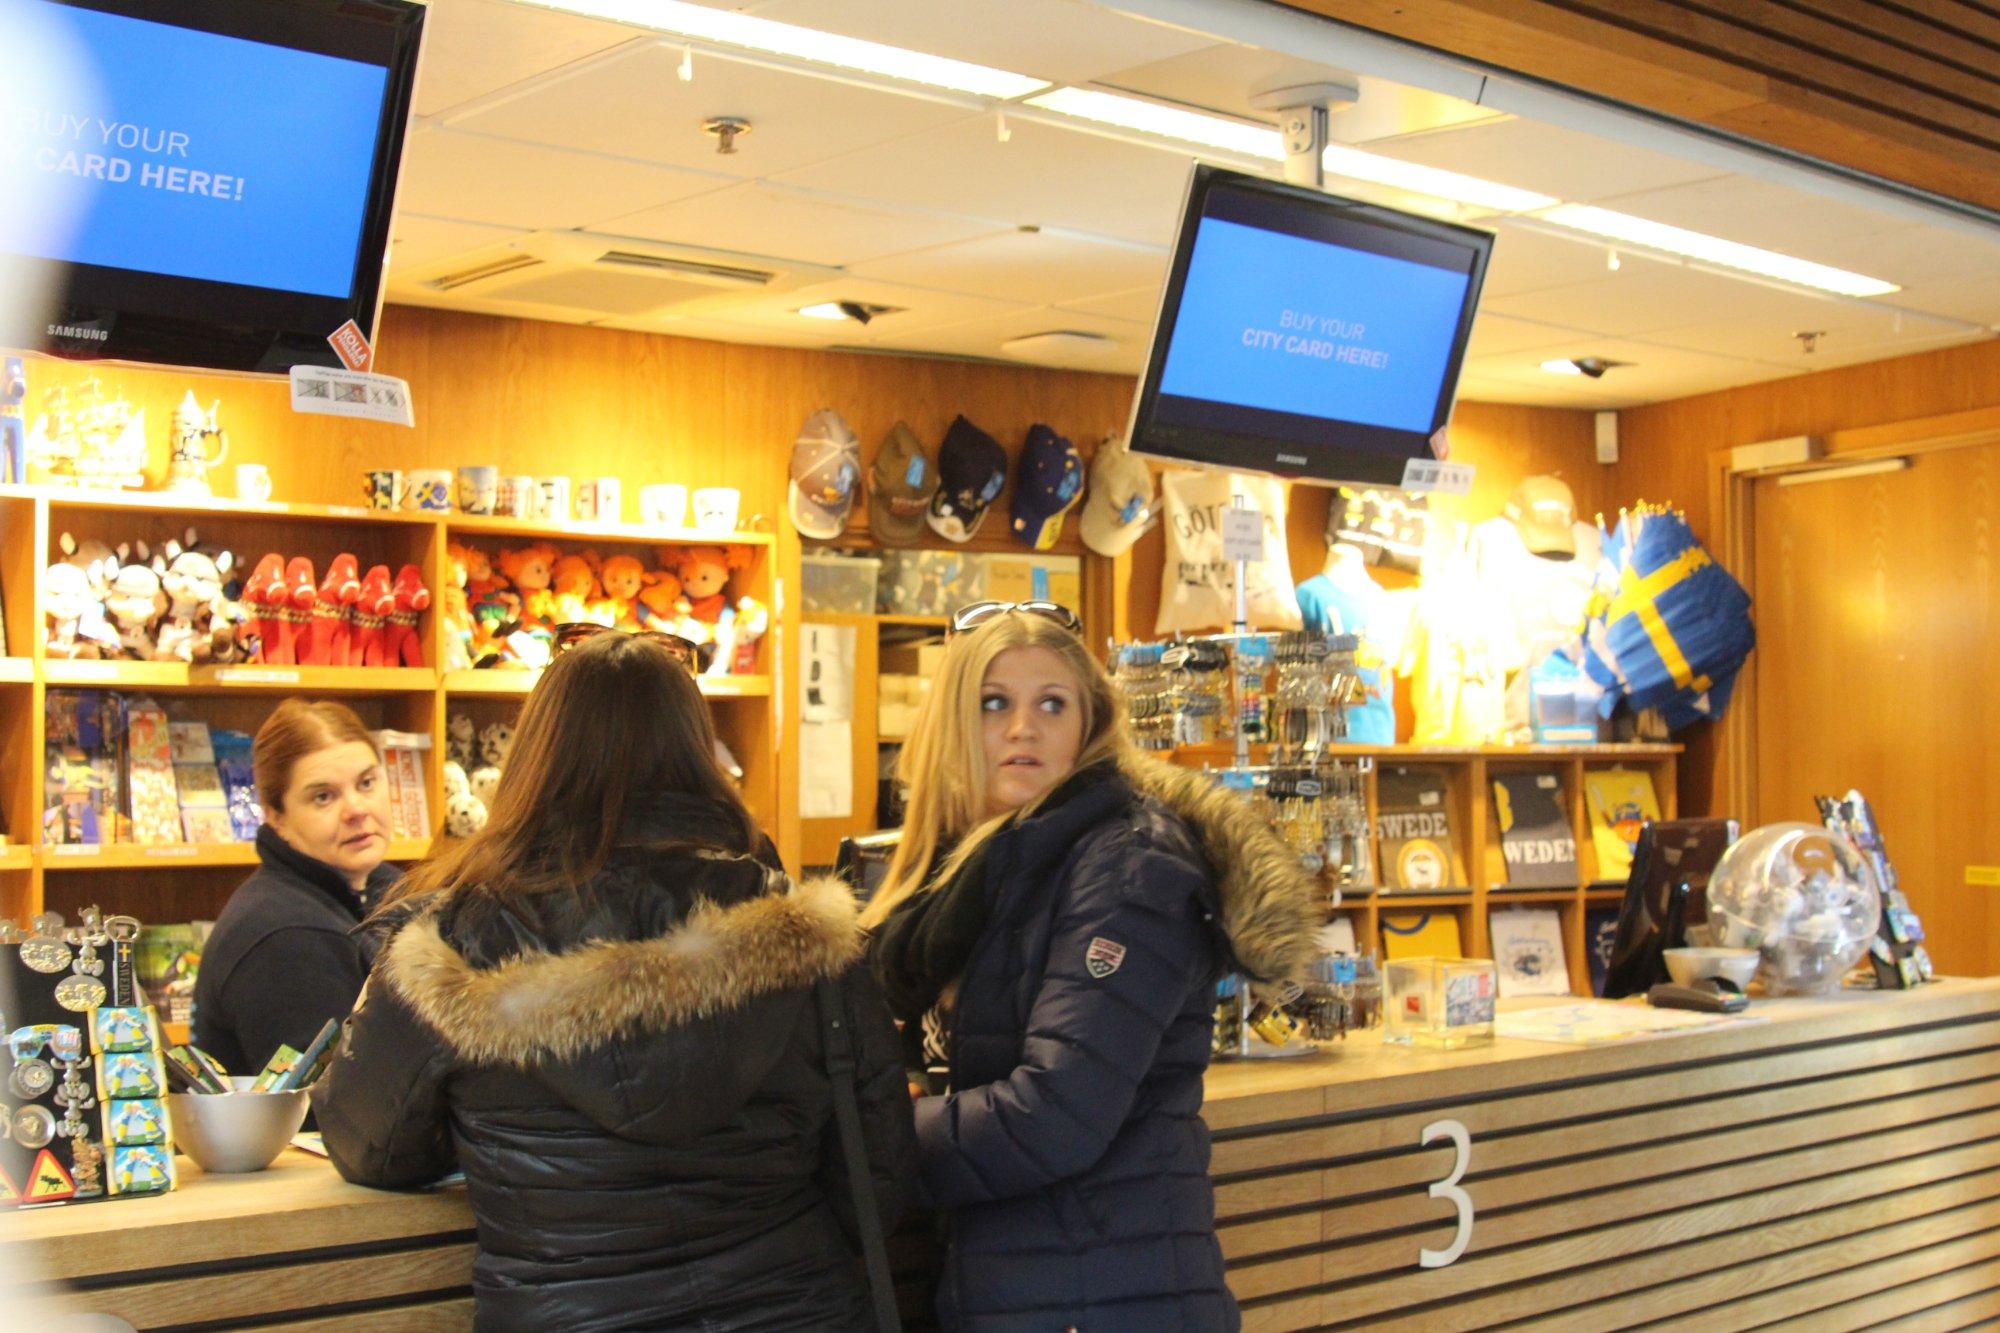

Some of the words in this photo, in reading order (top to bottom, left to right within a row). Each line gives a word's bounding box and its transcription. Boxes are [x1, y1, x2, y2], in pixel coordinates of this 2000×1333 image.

[98, 119, 190, 158] YOUR
[37, 147, 131, 183] CARD
[140, 162, 245, 201] HERE!
[47, 324, 109, 341] SAMSUNG
[1280, 309, 1318, 332] BUY
[1320, 317, 1365, 341] YOUR
[1241, 328, 1284, 351] CITY
[1285, 335, 1333, 360] CARD
[1336, 345, 1390, 369] HERE!
[1420, 1119, 1474, 1268] 3
